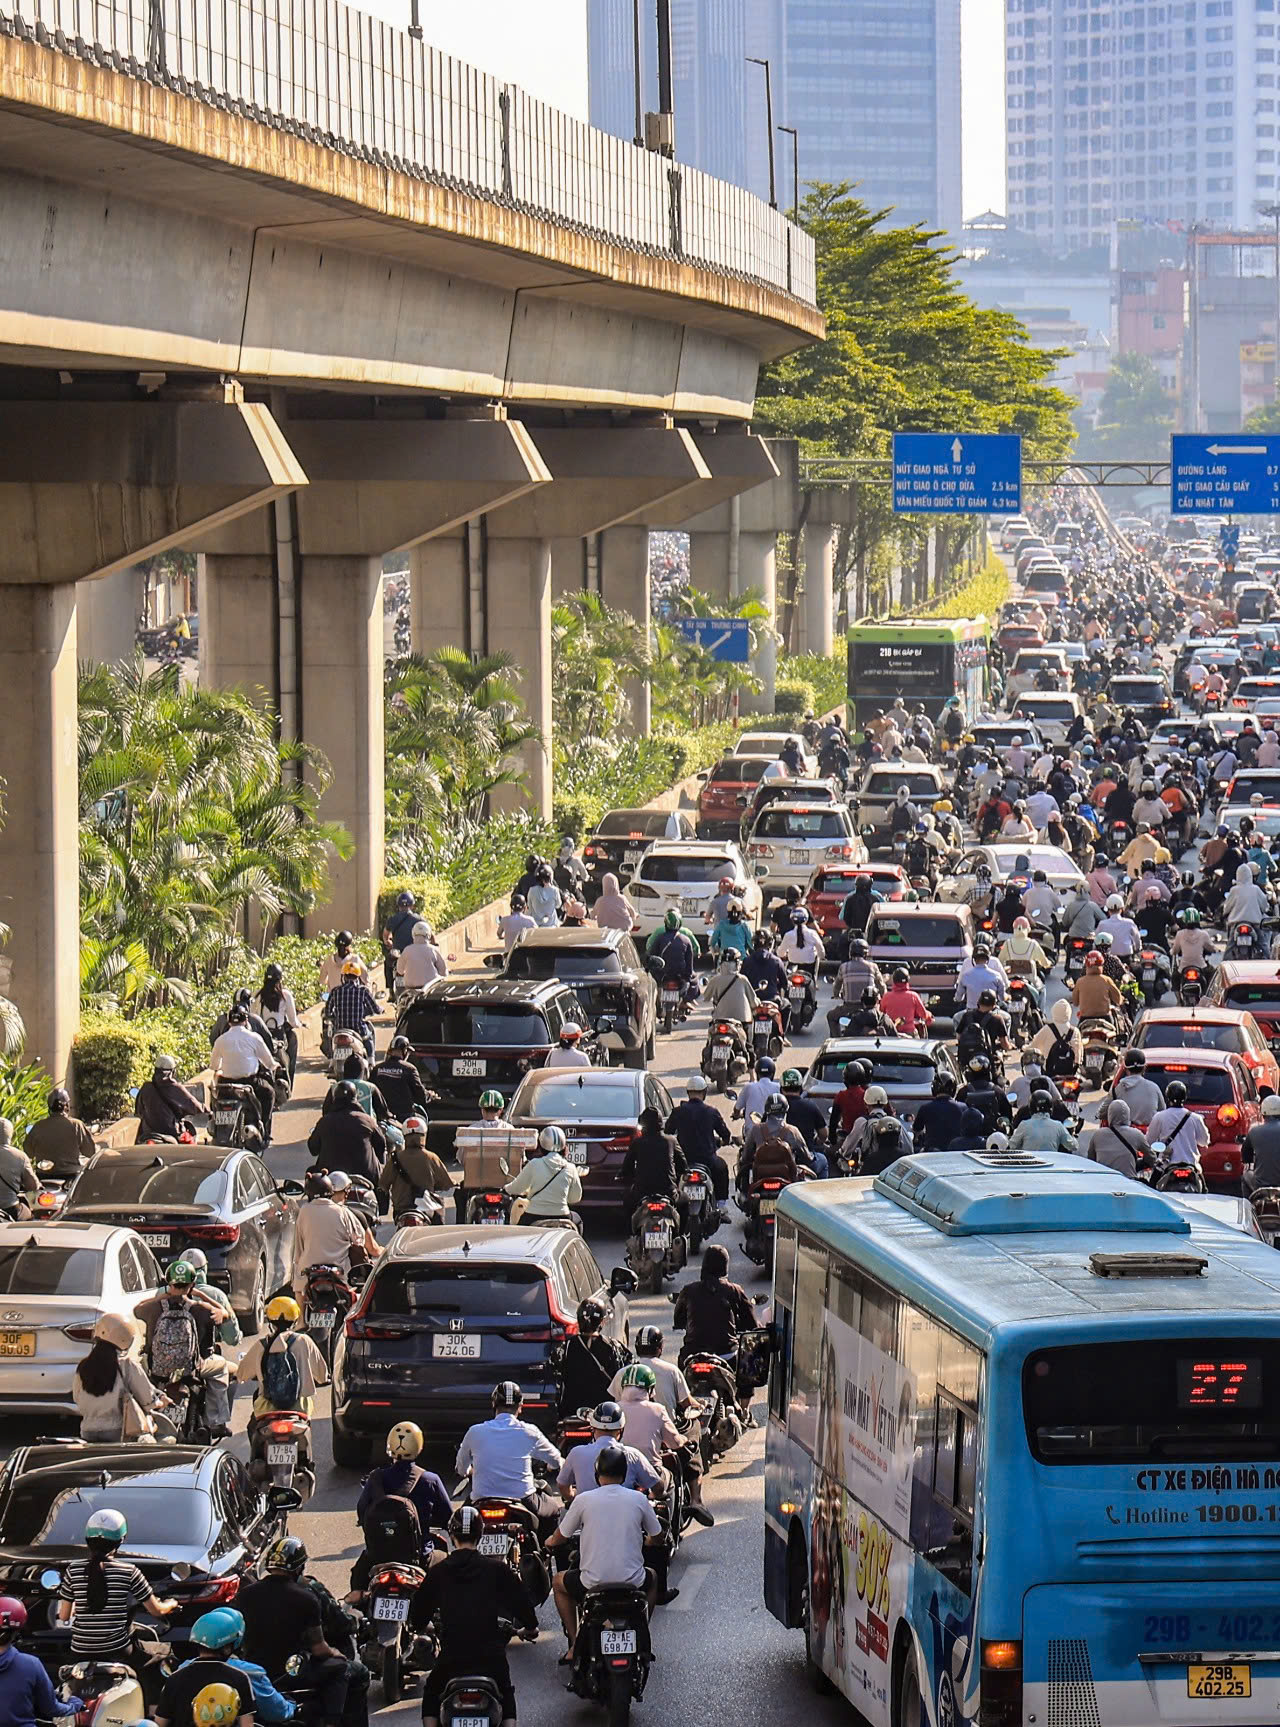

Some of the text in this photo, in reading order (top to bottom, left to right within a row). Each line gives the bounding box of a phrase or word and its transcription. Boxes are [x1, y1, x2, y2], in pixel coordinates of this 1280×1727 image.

[913, 464, 931, 475] GIAO
[933, 463, 949, 474] NGÃ
[1178, 463, 1204, 475] ĐƯỜNG
[913, 481, 931, 491] GIAO
[1005, 482, 1018, 492] km
[1195, 481, 1213, 491] GIAO
[1273, 482, 1279, 491] 5
[1005, 497, 1018, 507] km
[1271, 498, 1279, 508] 11
[447, 1335, 467, 1345] 30K
[439, 1346, 475, 1356] 734.06
[1190, 1363, 1247, 1402] 27
[1136, 1470, 1162, 1490] CT
[1164, 1470, 1186, 1490] XE
[1191, 1465, 1231, 1495] ĐIỆN
[1237, 1465, 1259, 1489] HÀ
[1126, 1507, 1189, 1524] Hotline
[856, 1511, 893, 1622] 30%
[1144, 1615, 1190, 1643] 29B
[1195, 1682, 1244, 1695] 402.25
